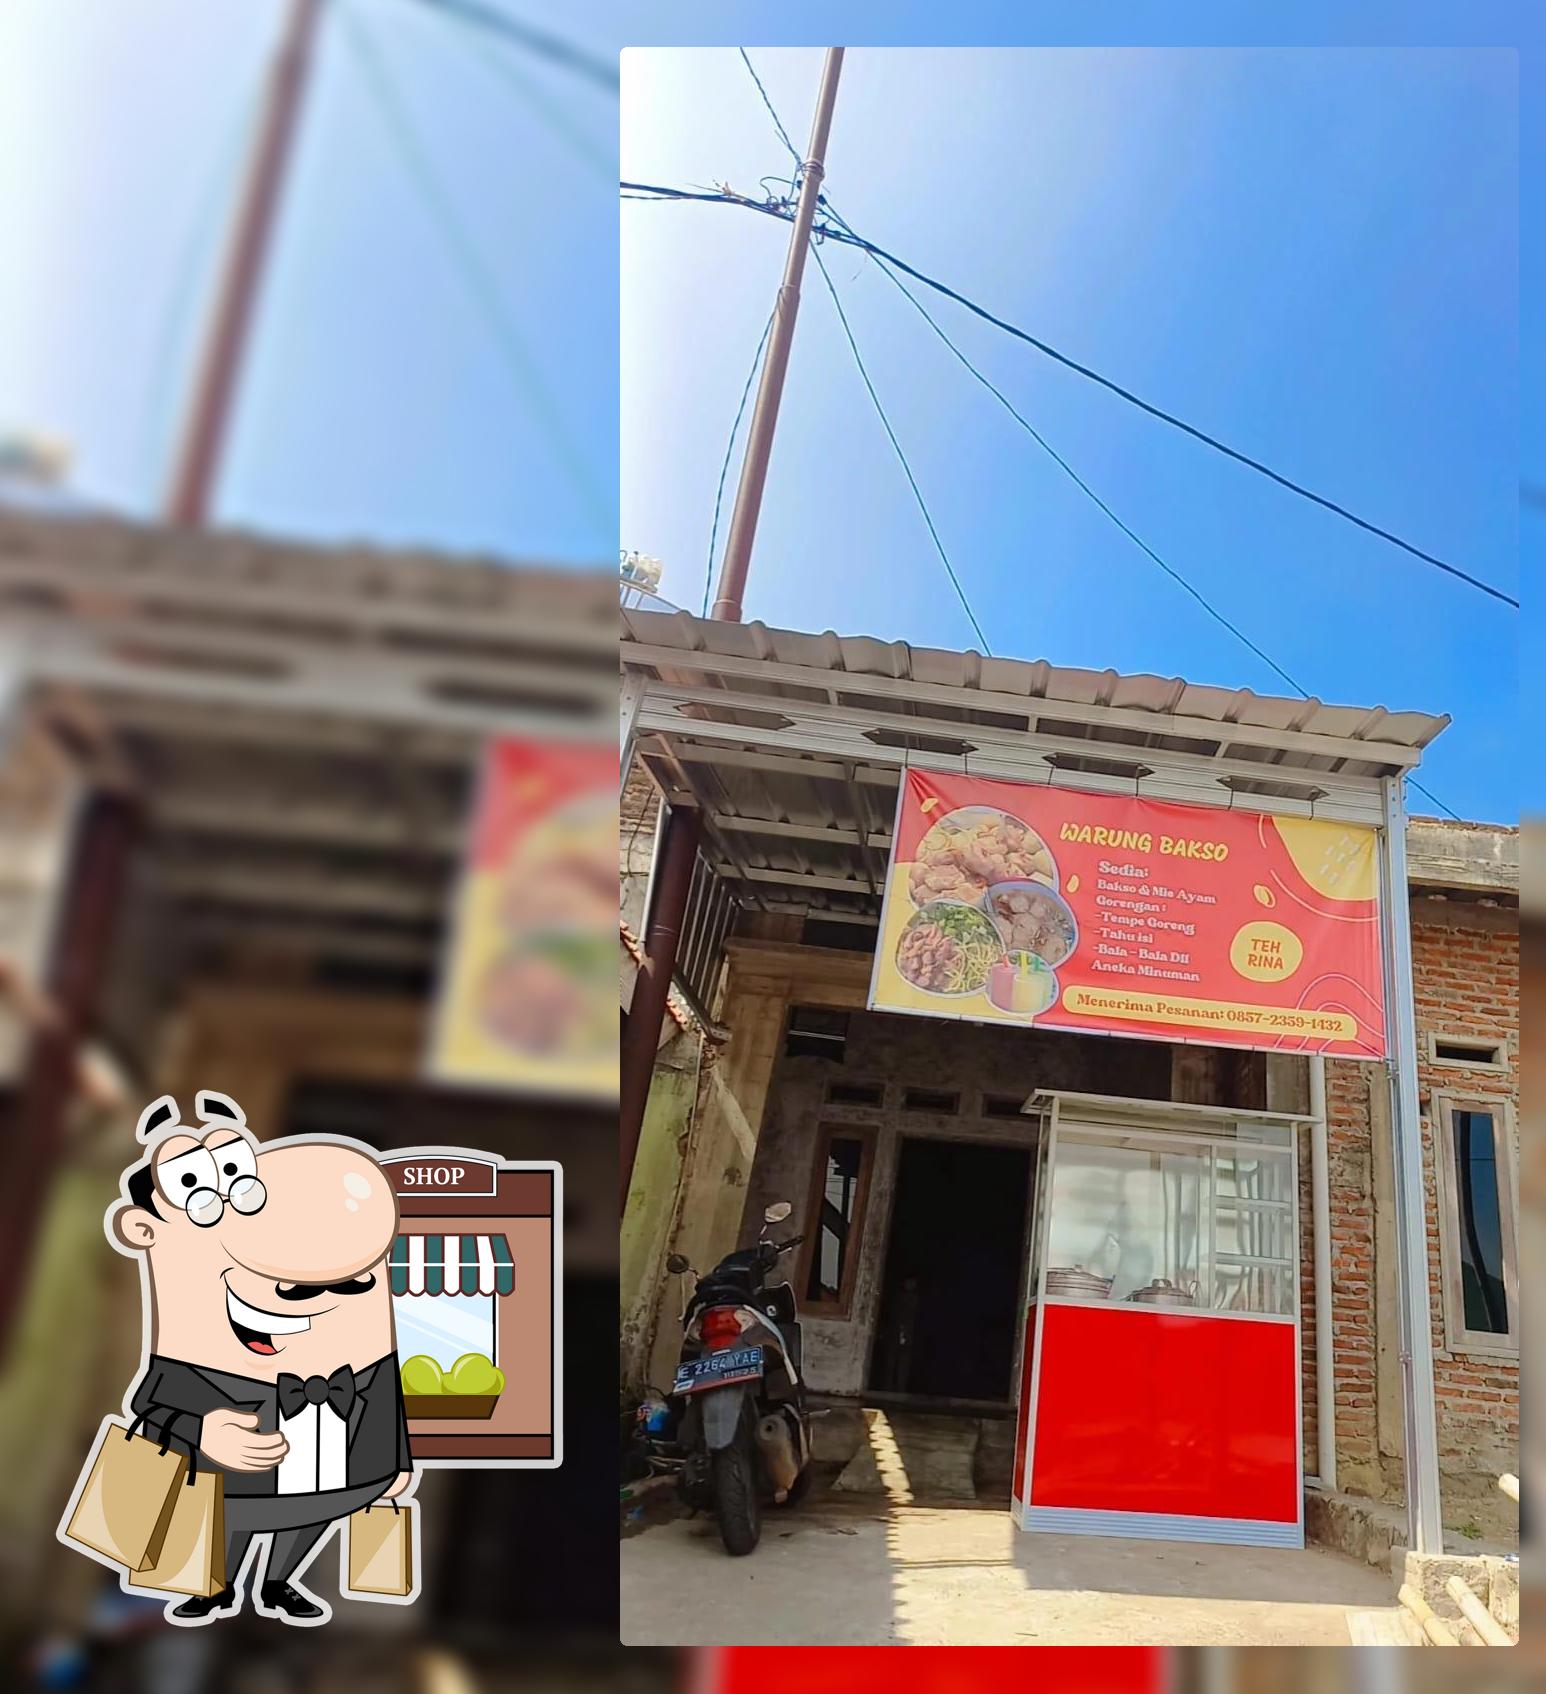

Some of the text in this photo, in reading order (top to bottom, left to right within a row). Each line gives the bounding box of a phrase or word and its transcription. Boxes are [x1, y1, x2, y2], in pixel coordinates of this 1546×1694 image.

[1060, 822, 1229, 862] WARUNG BAKSO
[1098, 860, 1149, 878] Sedia:
[1097, 879, 1137, 894] Bakso
[1138, 884, 1151, 896] &
[1176, 889, 1216, 905] Ayam
[1095, 911, 1196, 936] -Tempe Goreng
[1094, 927, 1154, 944] -Tahu isi
[1139, 948, 1168, 962] Bala
[1251, 938, 1281, 954] TEH
[1247, 953, 1284, 970] RINA
[1091, 960, 1201, 982] Aneka Minuman
[1076, 992, 1154, 1013] Menerima
[1156, 1003, 1225, 1020] Pesanan:
[733, 1350, 758, 1366] YAE
